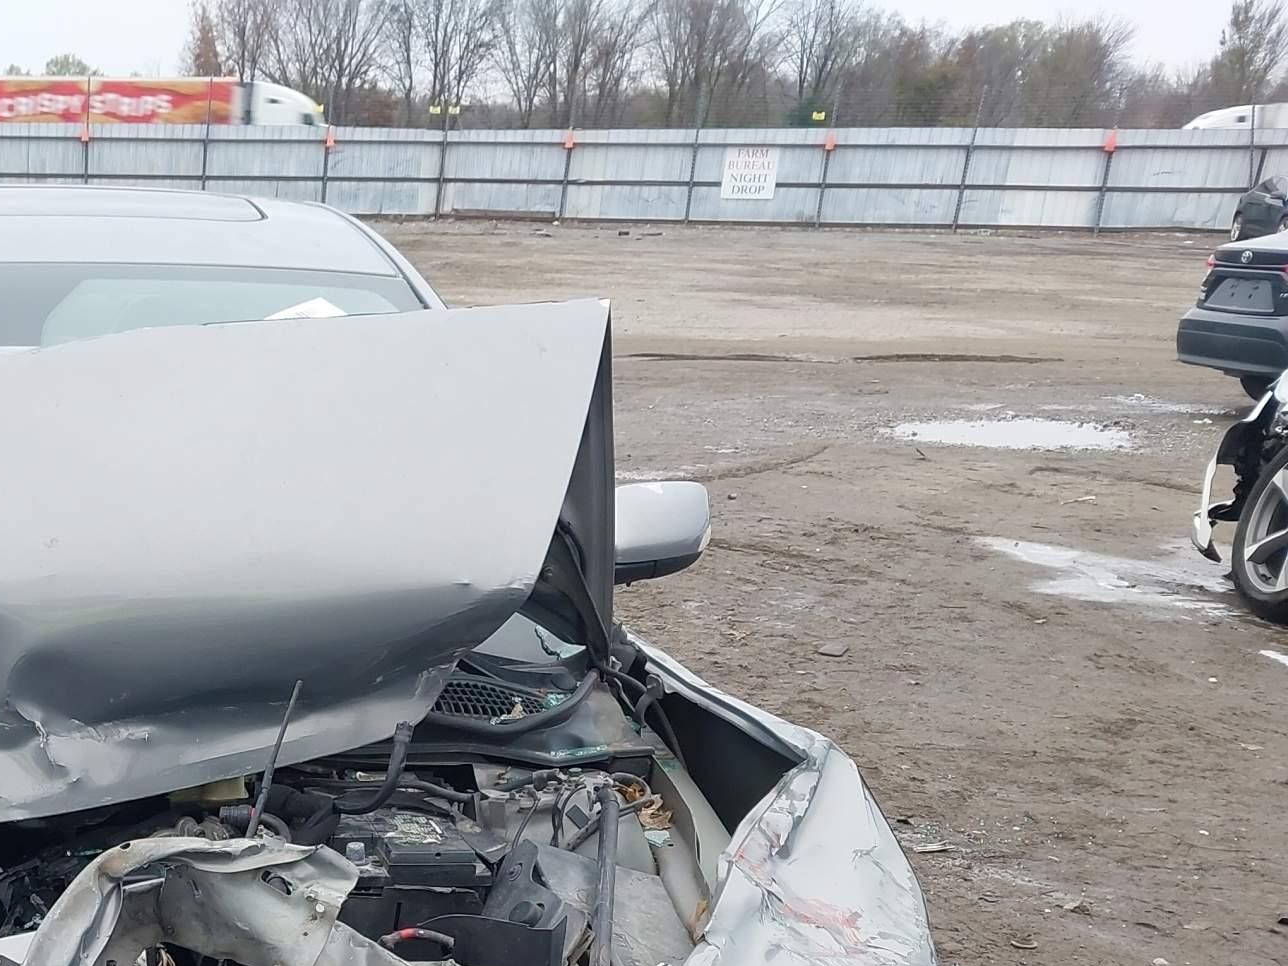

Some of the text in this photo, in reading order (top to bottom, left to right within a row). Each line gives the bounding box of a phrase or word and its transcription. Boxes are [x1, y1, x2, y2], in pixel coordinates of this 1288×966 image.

[737, 148, 770, 159] FARM
[728, 160, 774, 170] BUREAU
[730, 173, 768, 183] NIGHT
[731, 184, 765, 195] DROP
